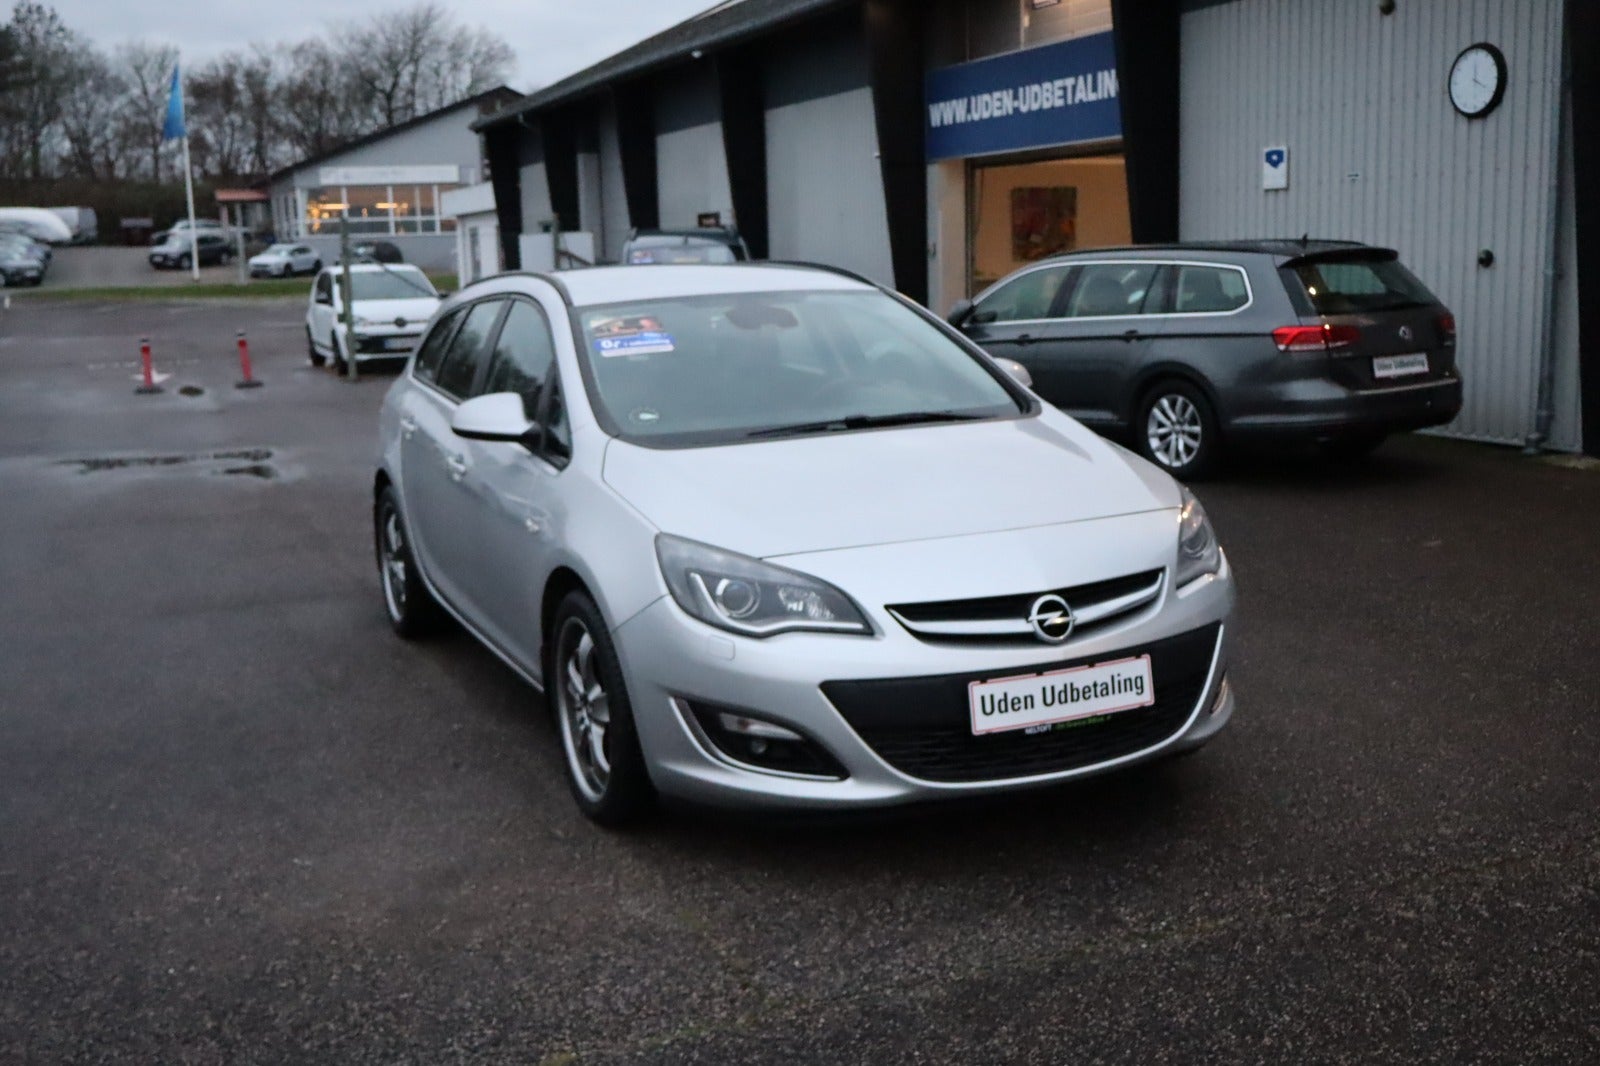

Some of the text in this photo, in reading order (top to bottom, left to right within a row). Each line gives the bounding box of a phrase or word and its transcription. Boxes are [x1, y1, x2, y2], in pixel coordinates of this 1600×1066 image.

[929, 69, 1119, 127] WWW.UDEN-UDBETALIN
[980, 673, 1144, 717] Uden Udbetaling
